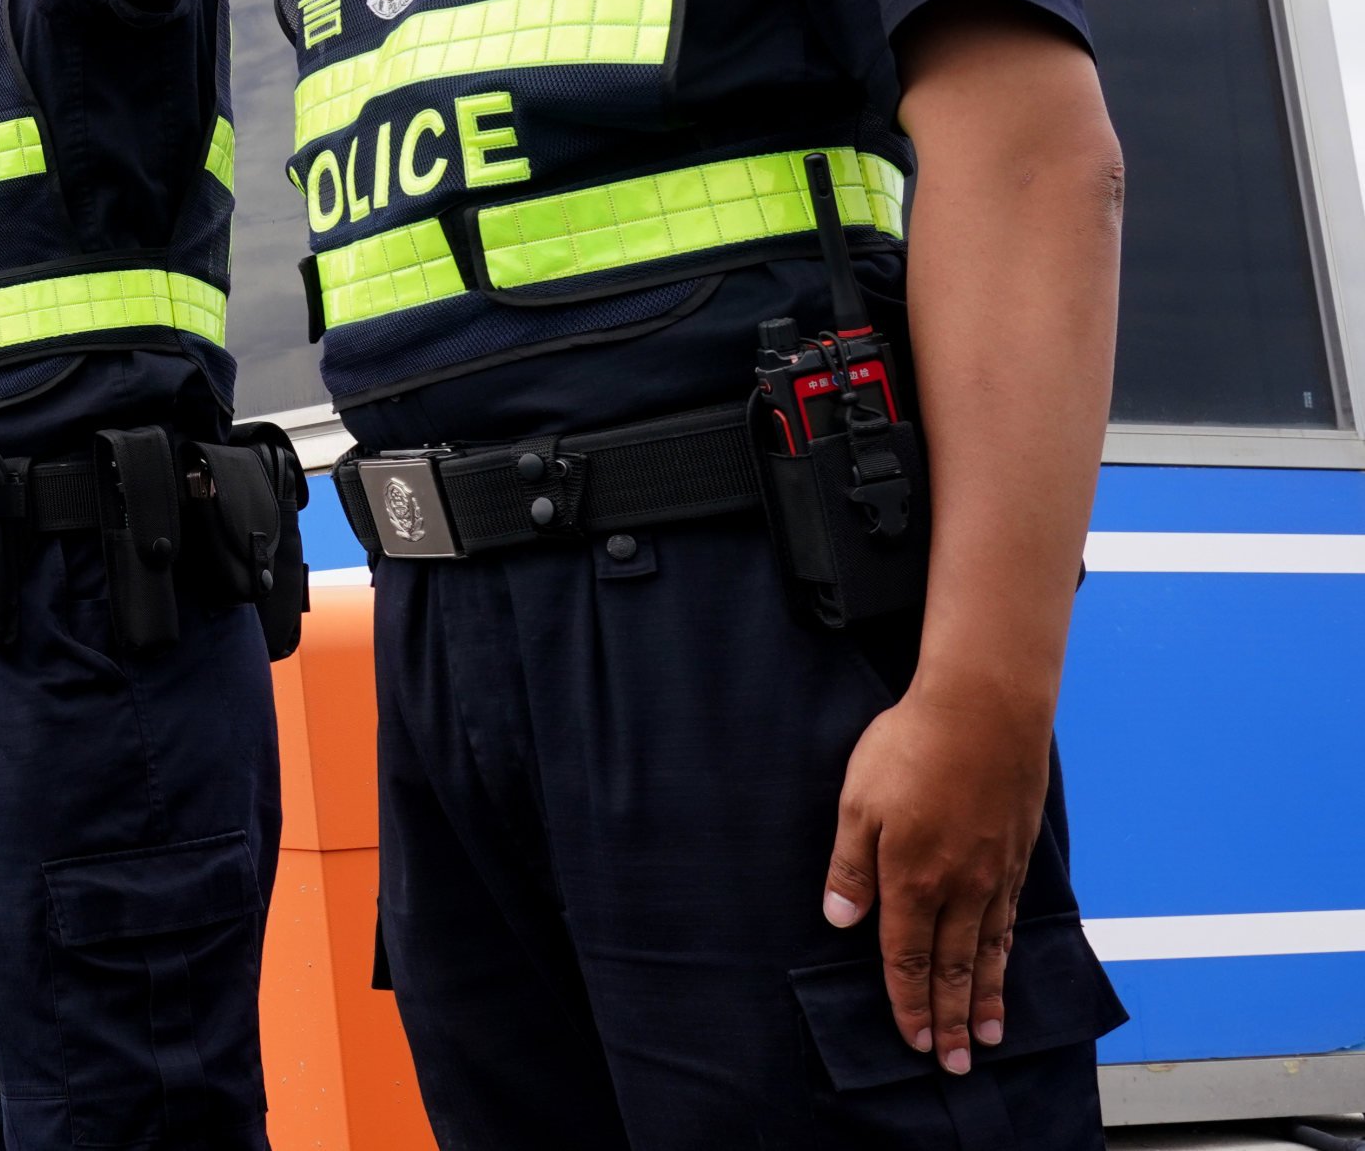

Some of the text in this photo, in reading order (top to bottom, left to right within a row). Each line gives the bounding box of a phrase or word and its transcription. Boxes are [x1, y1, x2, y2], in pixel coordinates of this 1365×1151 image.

[288, 90, 532, 235] OLICE
[808, 367, 870, 390] 中国 边检
